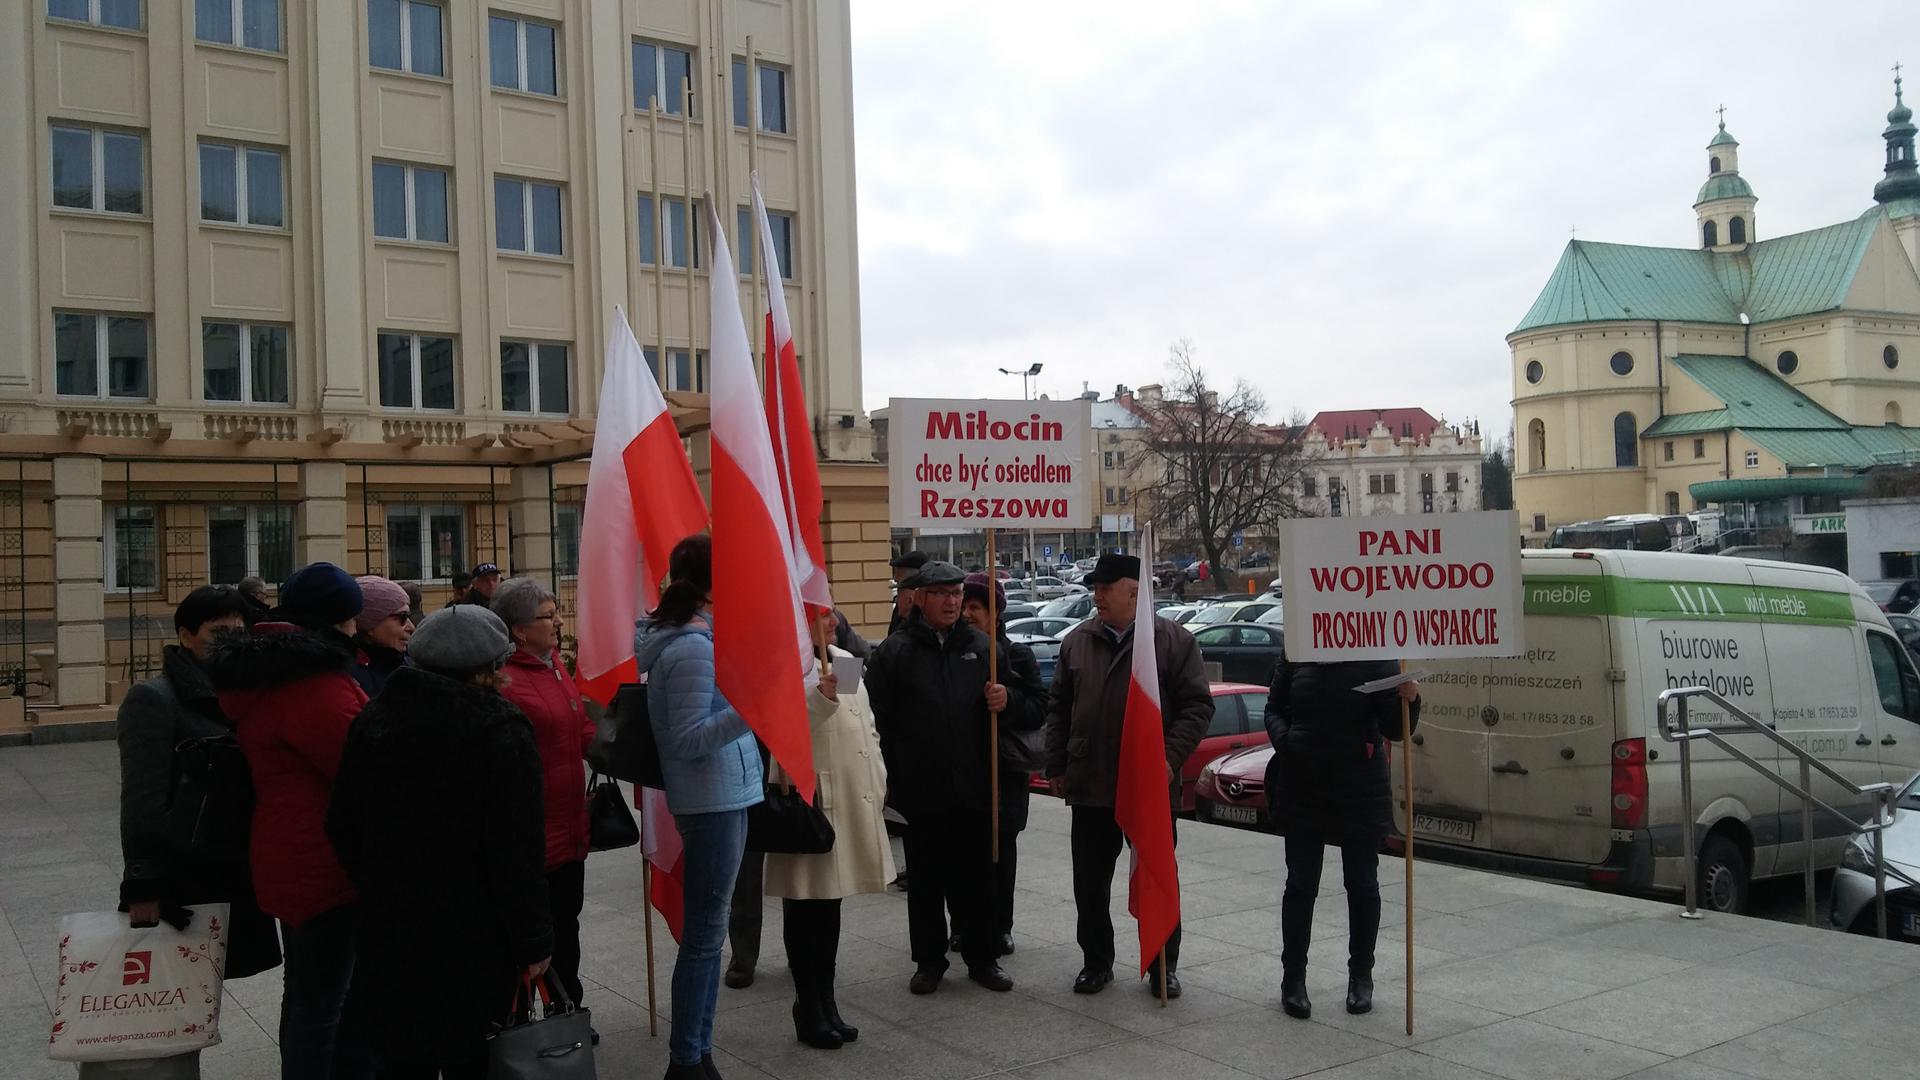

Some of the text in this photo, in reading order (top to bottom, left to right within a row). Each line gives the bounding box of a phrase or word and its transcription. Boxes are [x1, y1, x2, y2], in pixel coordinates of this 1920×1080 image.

[925, 410, 1063, 441] Miłocin
[915, 453, 1072, 491] chce być osiedlem
[921, 489, 1068, 518] Rzeszowa
[1359, 529, 1442, 556] PANI
[1310, 562, 1494, 598] WOJEWODO
[1532, 586, 1591, 603] meble
[1744, 591, 1808, 616] wid meble
[1312, 608, 1499, 648] PROSIMY O WSPARCIE
[1660, 629, 1739, 659] biurowe
[1482, 673, 1582, 690] pomieszczeń
[1562, 714, 1576, 725] 28
[1580, 716, 1594, 726] 58
[1416, 815, 1433, 830] RZ
[80, 987, 186, 1013] ELEGANZA
[76, 1028, 177, 1045] www.eleganza.com.pl
